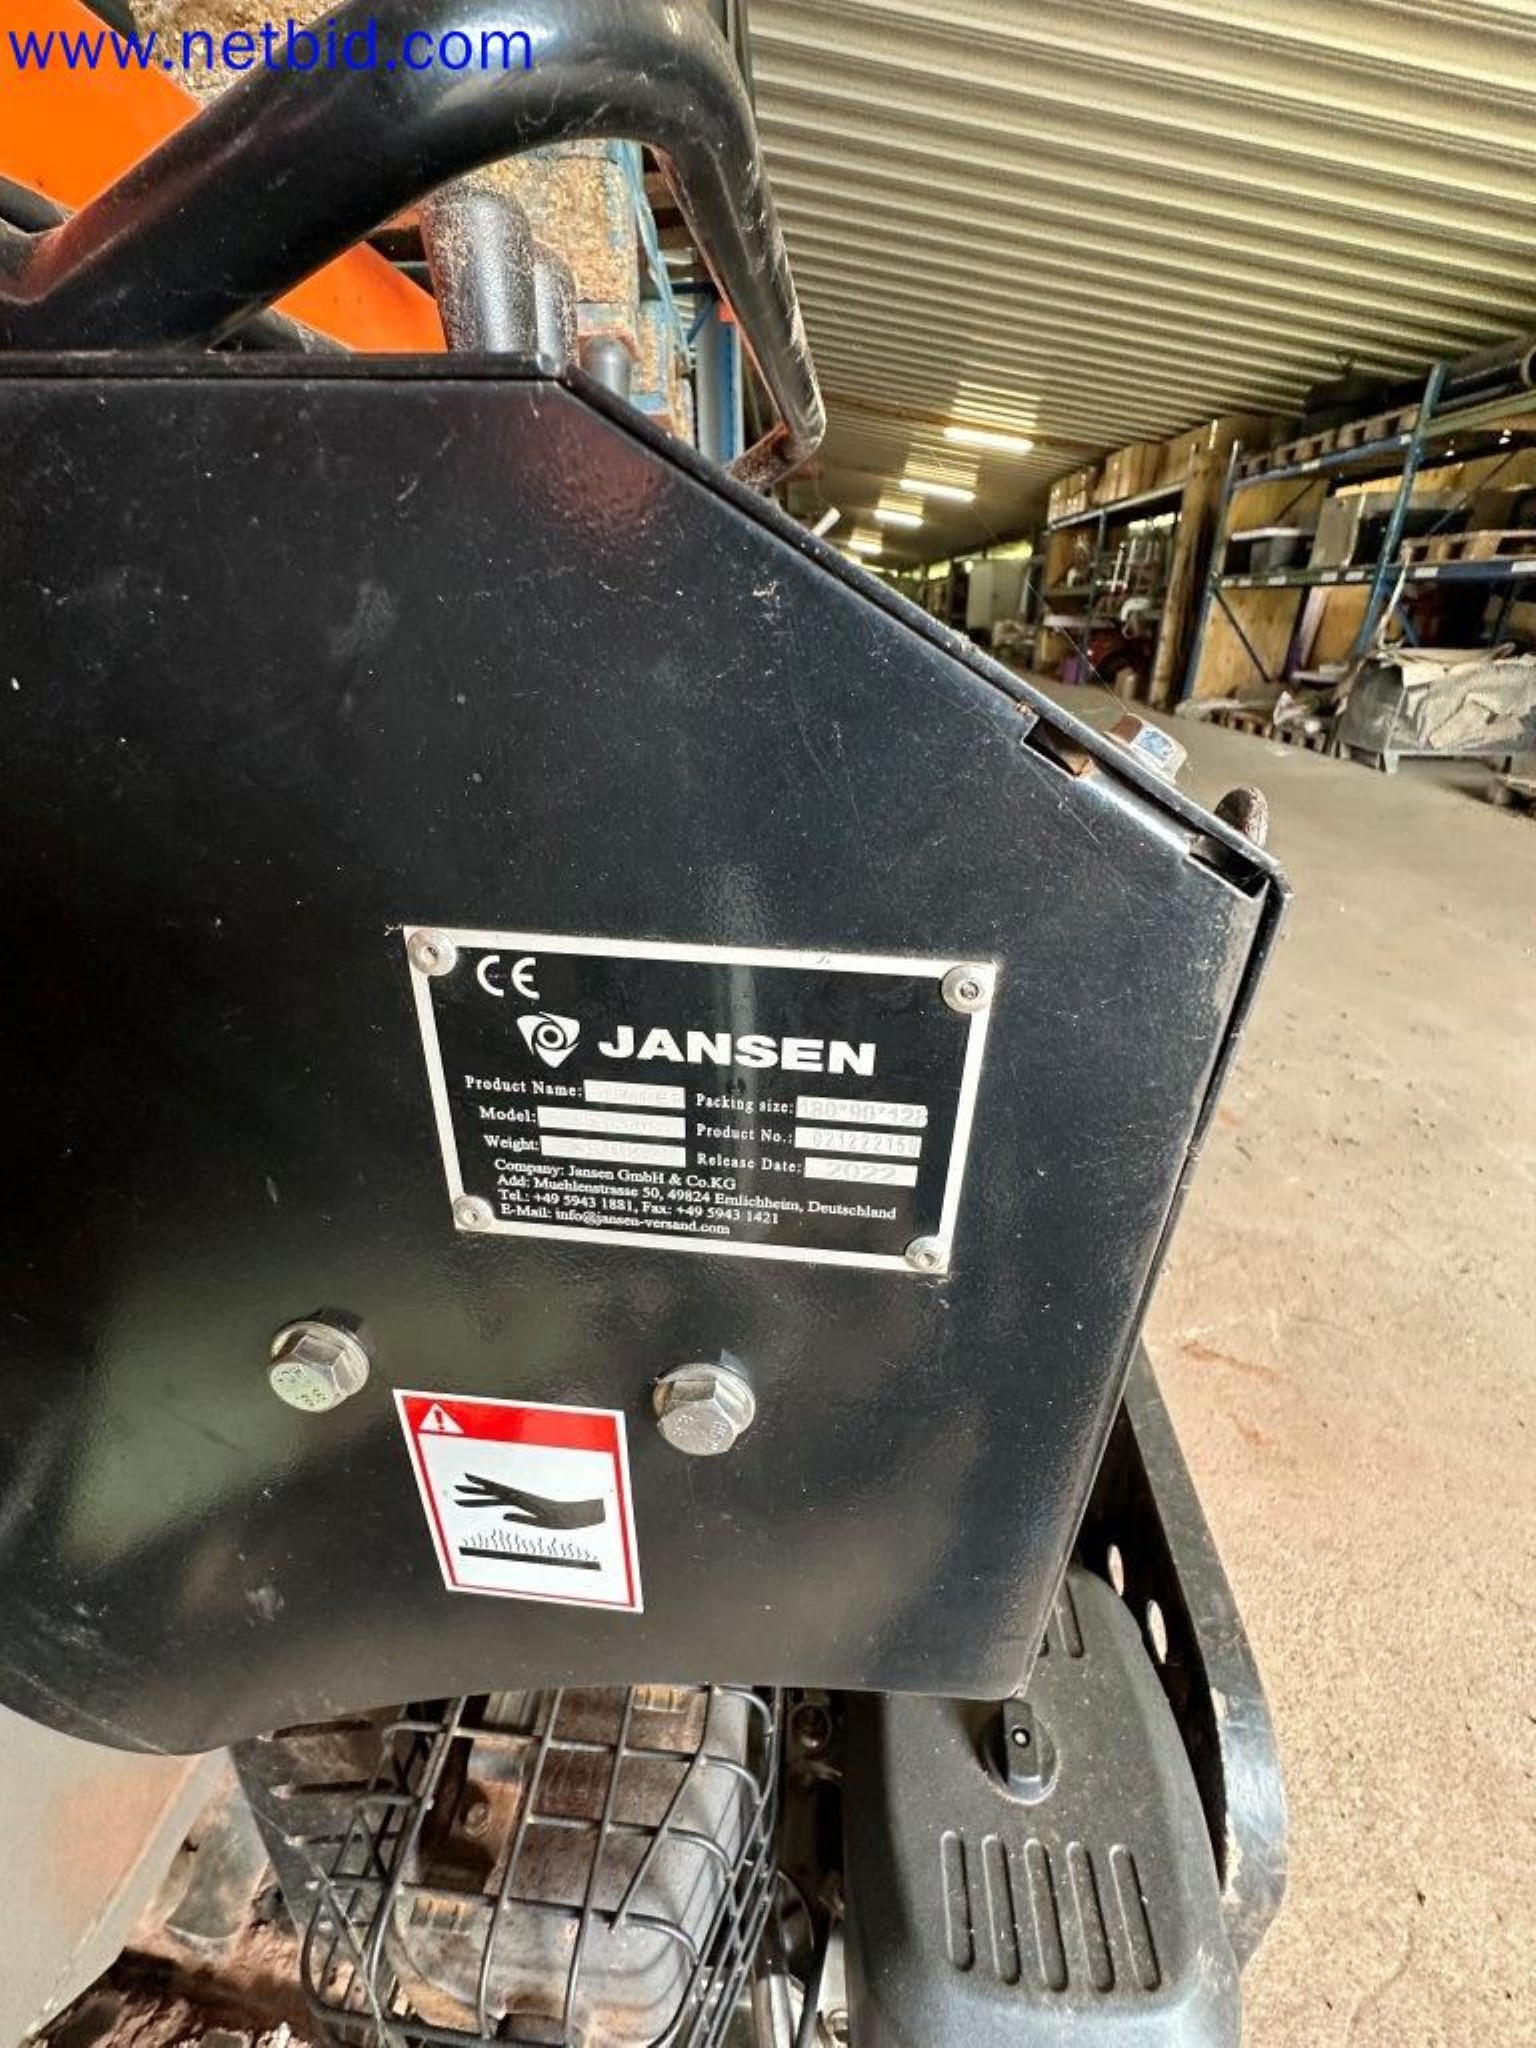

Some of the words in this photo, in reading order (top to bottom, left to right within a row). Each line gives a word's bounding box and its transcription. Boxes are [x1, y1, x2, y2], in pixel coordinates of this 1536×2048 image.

[598, 1025, 876, 1076] JANSEN
[465, 1075, 526, 1093] Product
[532, 1081, 583, 1098] Name:
[479, 1105, 537, 1123] Model:
[696, 1093, 754, 1114] Packing
[759, 1099, 794, 1114] size:
[483, 1134, 539, 1153] Weight:
[696, 1123, 754, 1141] Product
[761, 1129, 793, 1145] No.:
[494, 1158, 564, 1178] Company:
[568, 1165, 614, 1180] Jansen
[617, 1169, 665, 1185] GmbH
[669, 1174, 682, 1186] &
[686, 1175, 736, 1190] Co.KG
[697, 1152, 754, 1169] Release
[761, 1157, 802, 1174] Date:
[826, 1161, 897, 1181] 2022
[497, 1174, 530, 1188] Add:
[533, 1177, 638, 1197] Muehlenstrasse
[642, 1187, 664, 1202] 50,
[667, 1188, 710, 1203] 49824
[715, 1192, 804, 1213] Emlichheim,
[808, 1201, 897, 1220] Deutschland
[533, 1193, 560, 1205] +49
[563, 1195, 596, 1208] 5943
[642, 1201, 672, 1215] Fax:
[676, 1204, 703, 1217] +49
[707, 1207, 741, 1221] 5943
[746, 1210, 779, 1224] 1421
[500, 1203, 552, 1218] E-Mail:
[555, 1209, 731, 1235] info@jansen-versand.com
